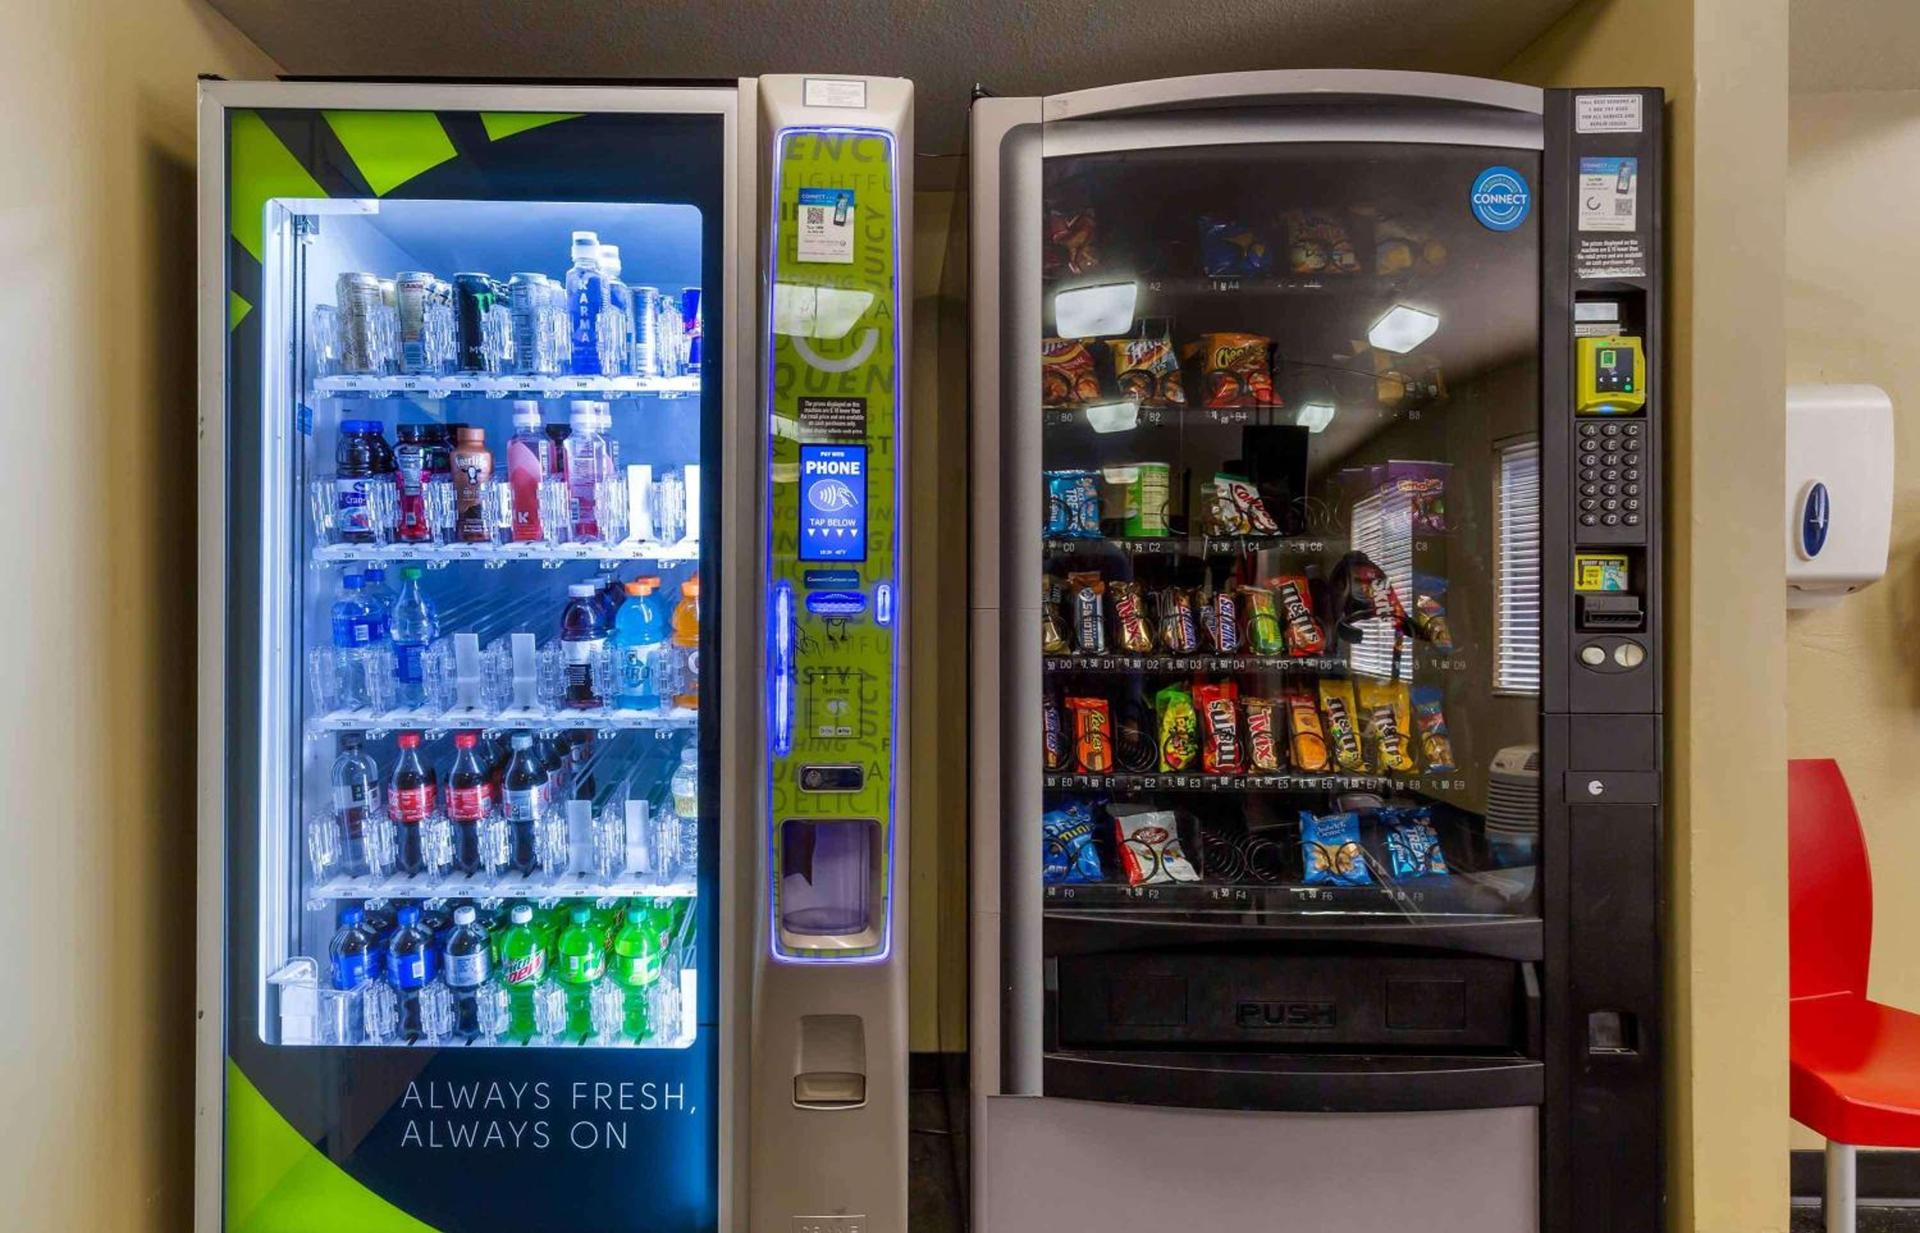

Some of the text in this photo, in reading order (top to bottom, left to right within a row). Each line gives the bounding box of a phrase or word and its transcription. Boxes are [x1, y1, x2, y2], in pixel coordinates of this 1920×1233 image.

[1473, 193, 1527, 205] CONNECT
[579, 278, 592, 342] KARMA
[1587, 425, 1595, 434] A
[1608, 425, 1617, 434] B
[1629, 425, 1638, 434] C
[1587, 440, 1595, 450] D
[1608, 440, 1617, 450] E
[1629, 440, 1638, 450] F
[1587, 455, 1595, 465] G
[1608, 455, 1617, 465] H
[1629, 455, 1638, 465] J
[806, 461, 860, 475] PHONE
[1608, 470, 1617, 479] 2
[1629, 470, 1638, 479] 3
[1587, 485, 1595, 494] 4
[1608, 485, 1617, 494] 5
[1629, 485, 1638, 494] 6
[1587, 500, 1595, 509] 7
[1608, 500, 1617, 509] 8
[1629, 500, 1638, 509] 9
[810, 518, 825, 526] TAP
[1608, 515, 1617, 524] 0
[1149, 543, 1161, 552] C2
[1248, 543, 1260, 552] C4
[1103, 660, 1115, 669] D1
[1234, 660, 1245, 669] D4
[1144, 778, 1155, 788] E2
[1234, 779, 1245, 788] E4
[1278, 779, 1288, 789] E5
[1149, 889, 1159, 899] F2
[1240, 1002, 1335, 1025] PUSH
[401, 1081, 696, 1114] ALWAYS FRESH,
[401, 1120, 628, 1149] ALWAYS ON
